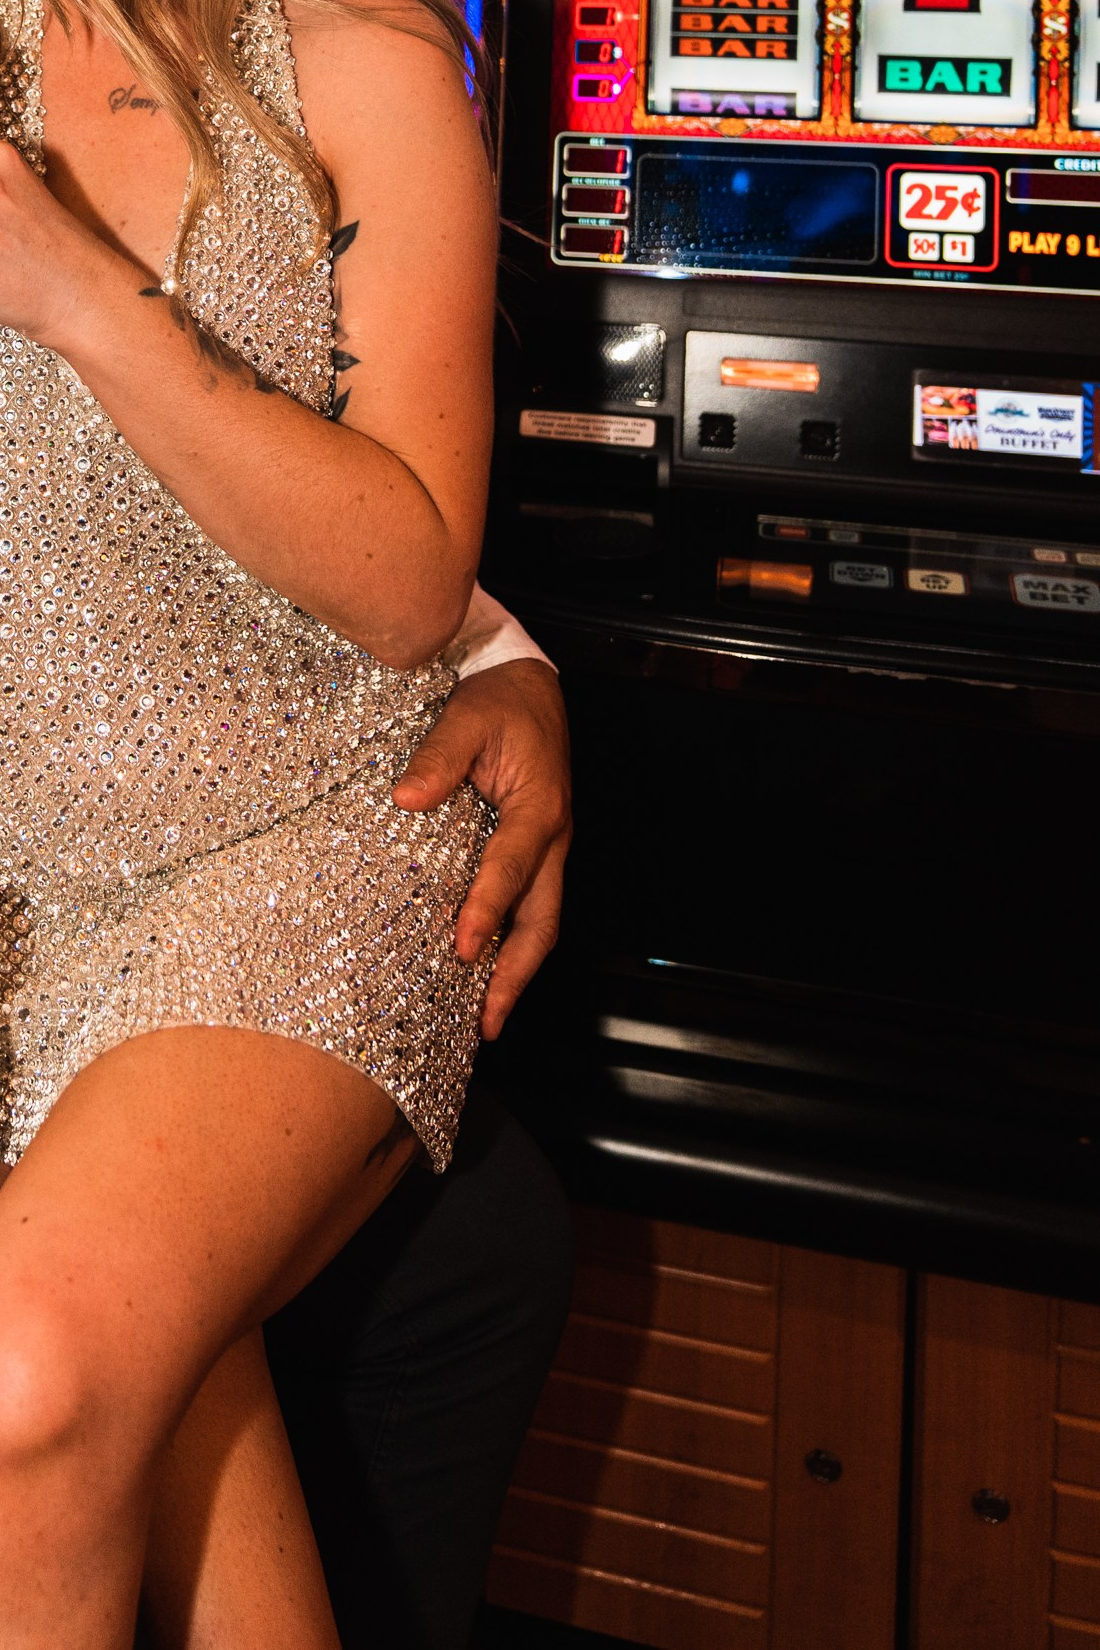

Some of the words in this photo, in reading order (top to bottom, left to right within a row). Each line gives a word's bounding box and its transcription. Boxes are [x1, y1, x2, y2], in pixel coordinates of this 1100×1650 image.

[679, 13, 789, 33] BAR
[678, 38, 788, 59] BAR
[885, 59, 1003, 94] BAR
[677, 91, 788, 116] BAR
[905, 181, 982, 222] 25¢
[1009, 231, 1062, 255] PLAY
[1066, 234, 1082, 257] 9
[933, 271, 953, 280] BET
[1000, 437, 1059, 451] BUFFET
[1022, 579, 1092, 596] MAX
[1029, 593, 1090, 607] BET
